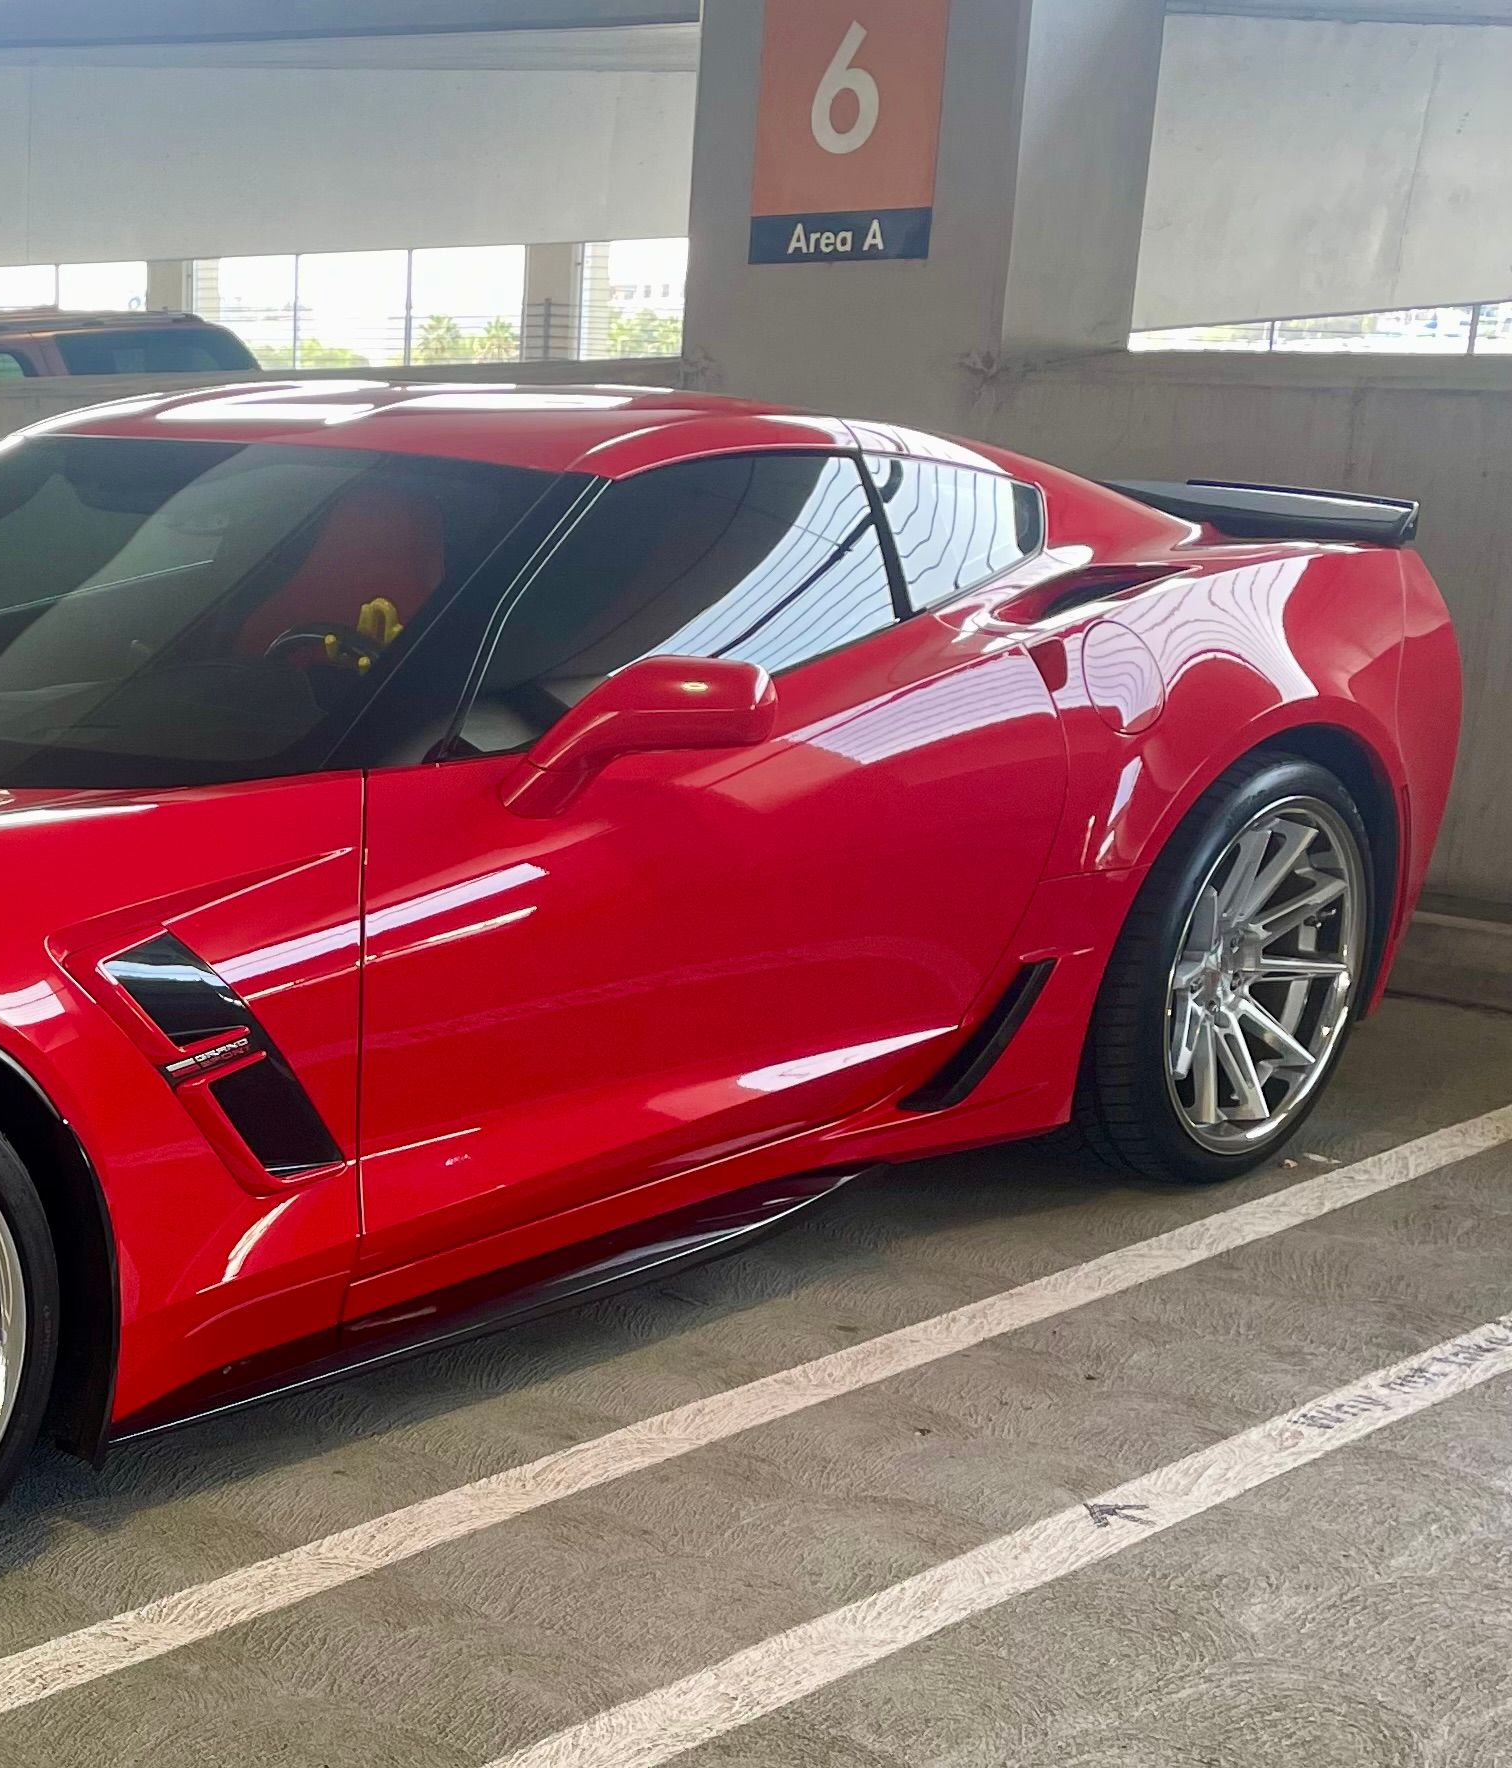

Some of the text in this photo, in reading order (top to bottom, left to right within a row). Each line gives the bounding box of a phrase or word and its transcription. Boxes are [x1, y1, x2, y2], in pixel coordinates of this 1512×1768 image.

[811, 20, 880, 155] 6
[787, 218, 885, 254] Area A
[195, 1038, 248, 1062] GRAND
